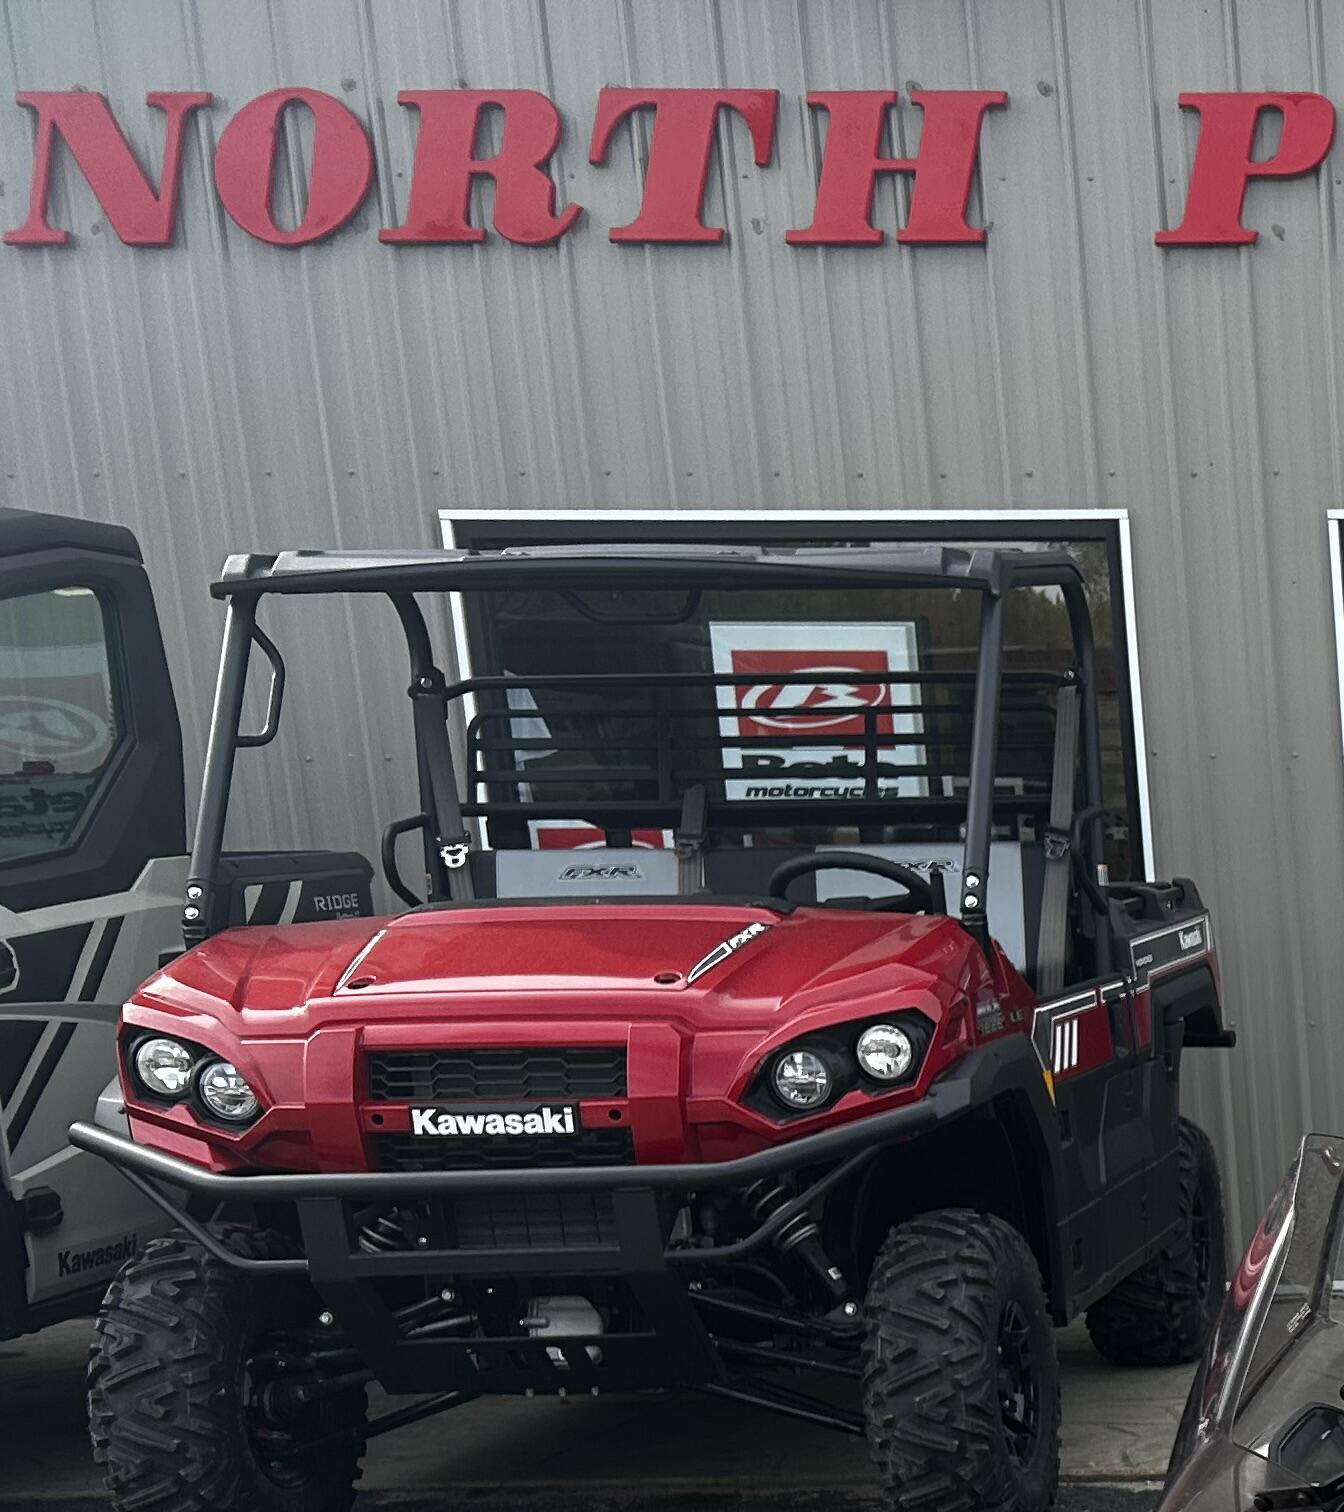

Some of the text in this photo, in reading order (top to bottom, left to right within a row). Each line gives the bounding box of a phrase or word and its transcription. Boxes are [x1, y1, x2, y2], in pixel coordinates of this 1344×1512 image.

[2, 86, 1008, 248] NORTH
[313, 893, 359, 912] RIDGE
[411, 1105, 575, 1136] Kawasaki
[58, 1233, 137, 1277] Kawasaki
